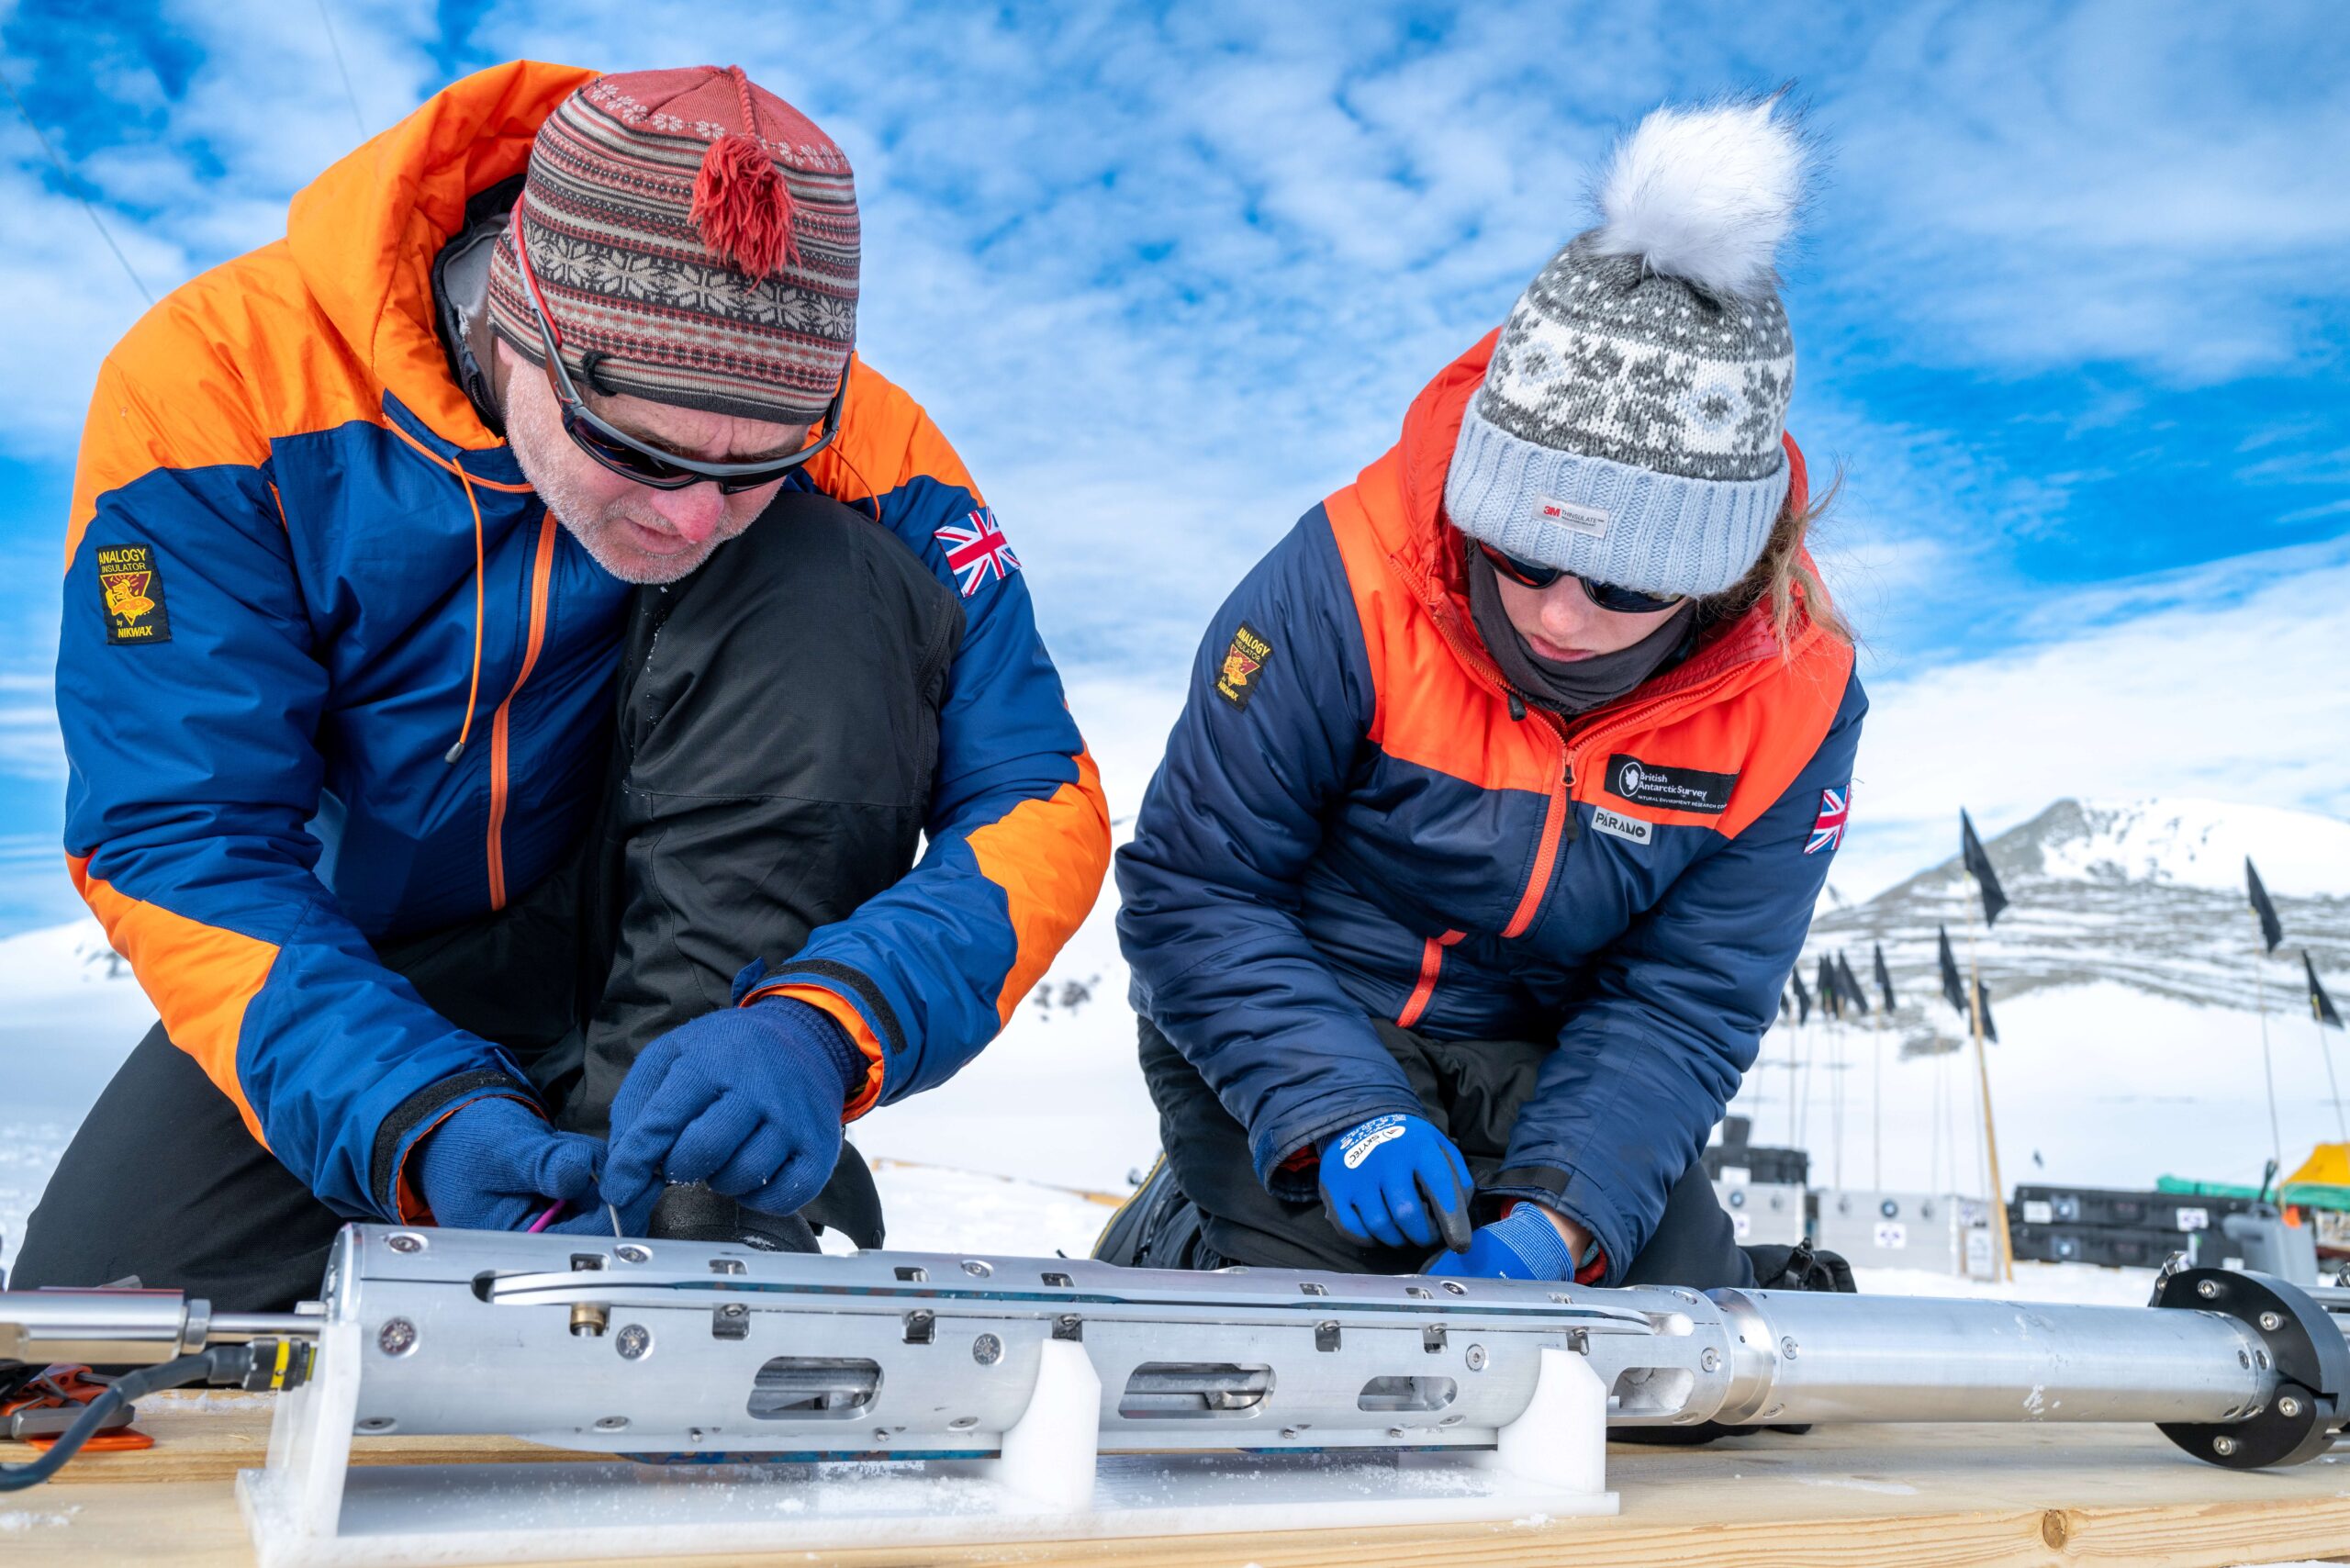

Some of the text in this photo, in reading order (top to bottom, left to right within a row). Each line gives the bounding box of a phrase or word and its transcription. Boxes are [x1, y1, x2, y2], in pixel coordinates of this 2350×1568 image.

[1543, 506, 1561, 517] 3M
[99, 549, 146, 565] ANALOGY
[102, 563, 147, 573] INSULATOR
[118, 626, 152, 638] NIKWAX
[1237, 627, 1270, 657] ANALOGY
[1639, 772, 1668, 783] British
[1638, 782, 1707, 800] Antarctic Survey
[1349, 1134, 1380, 1163] SKYTEC
